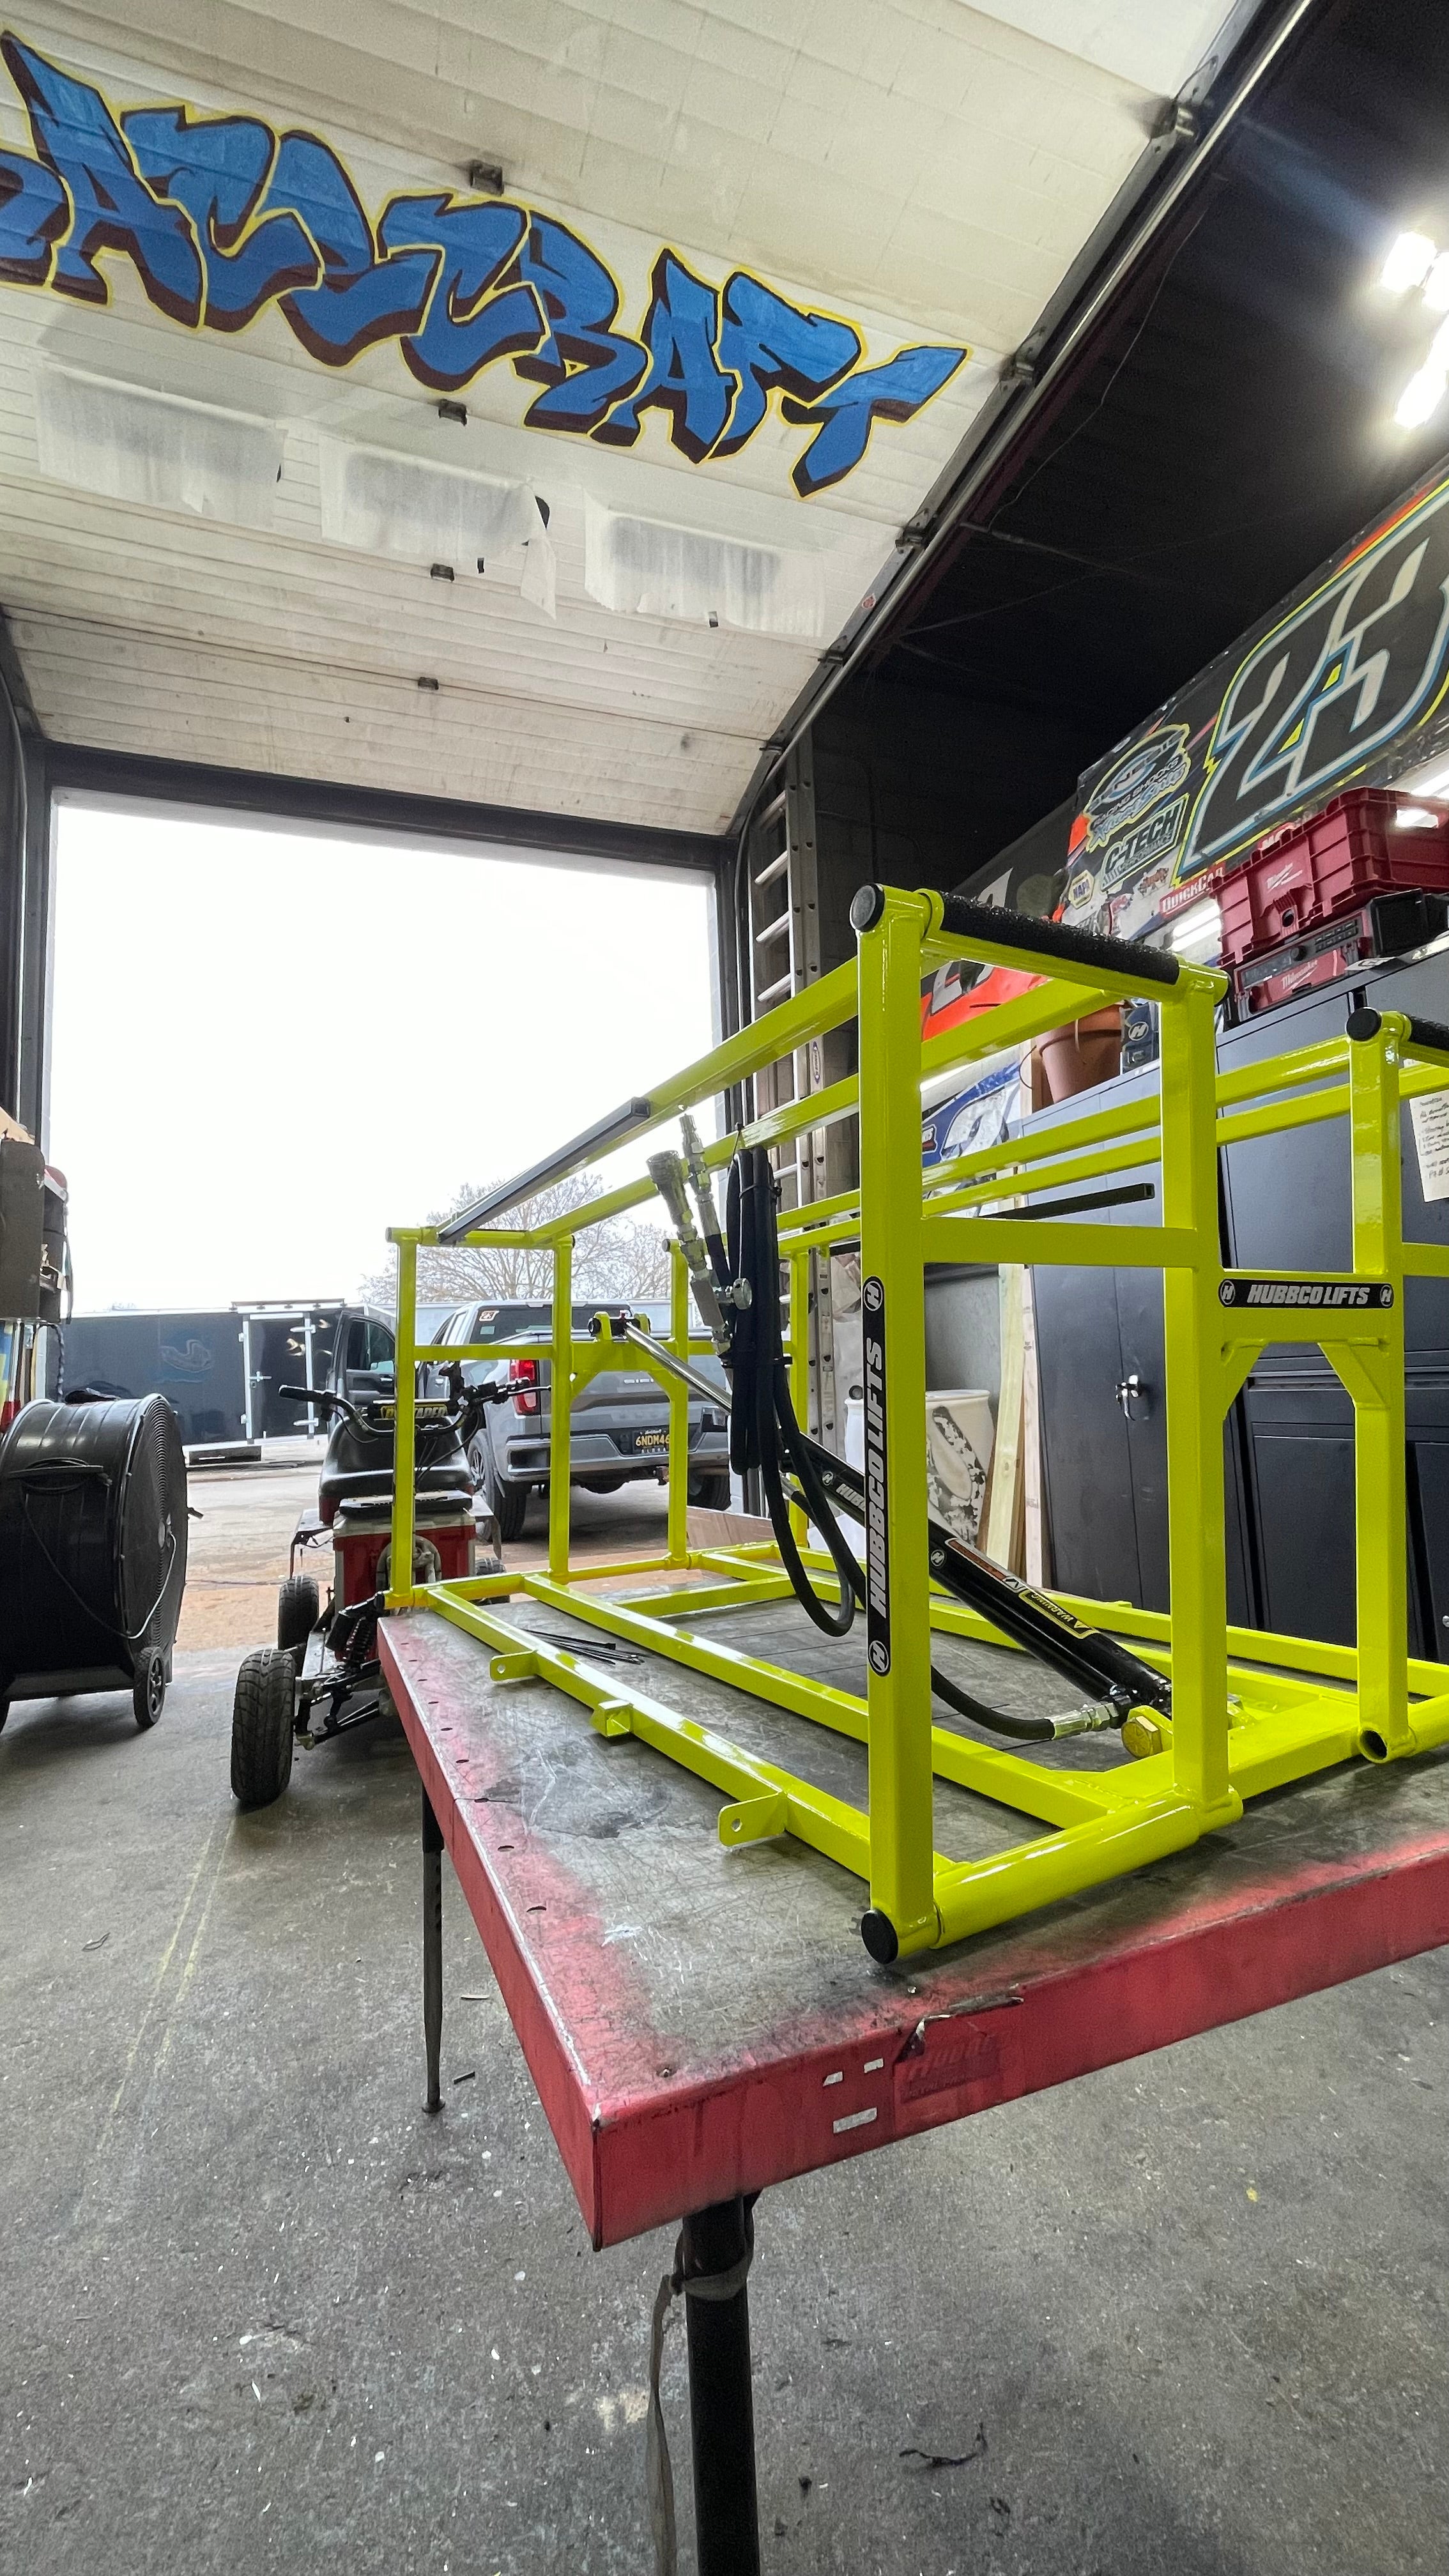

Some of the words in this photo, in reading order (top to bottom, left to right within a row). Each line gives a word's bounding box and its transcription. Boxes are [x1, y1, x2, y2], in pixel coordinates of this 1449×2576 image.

[1093, 793, 1131, 829] RACING
[1132, 756, 1180, 798] SHOCKS
[1105, 803, 1181, 875] C-TECH
[1031, 1592, 1074, 1623] WARNING
